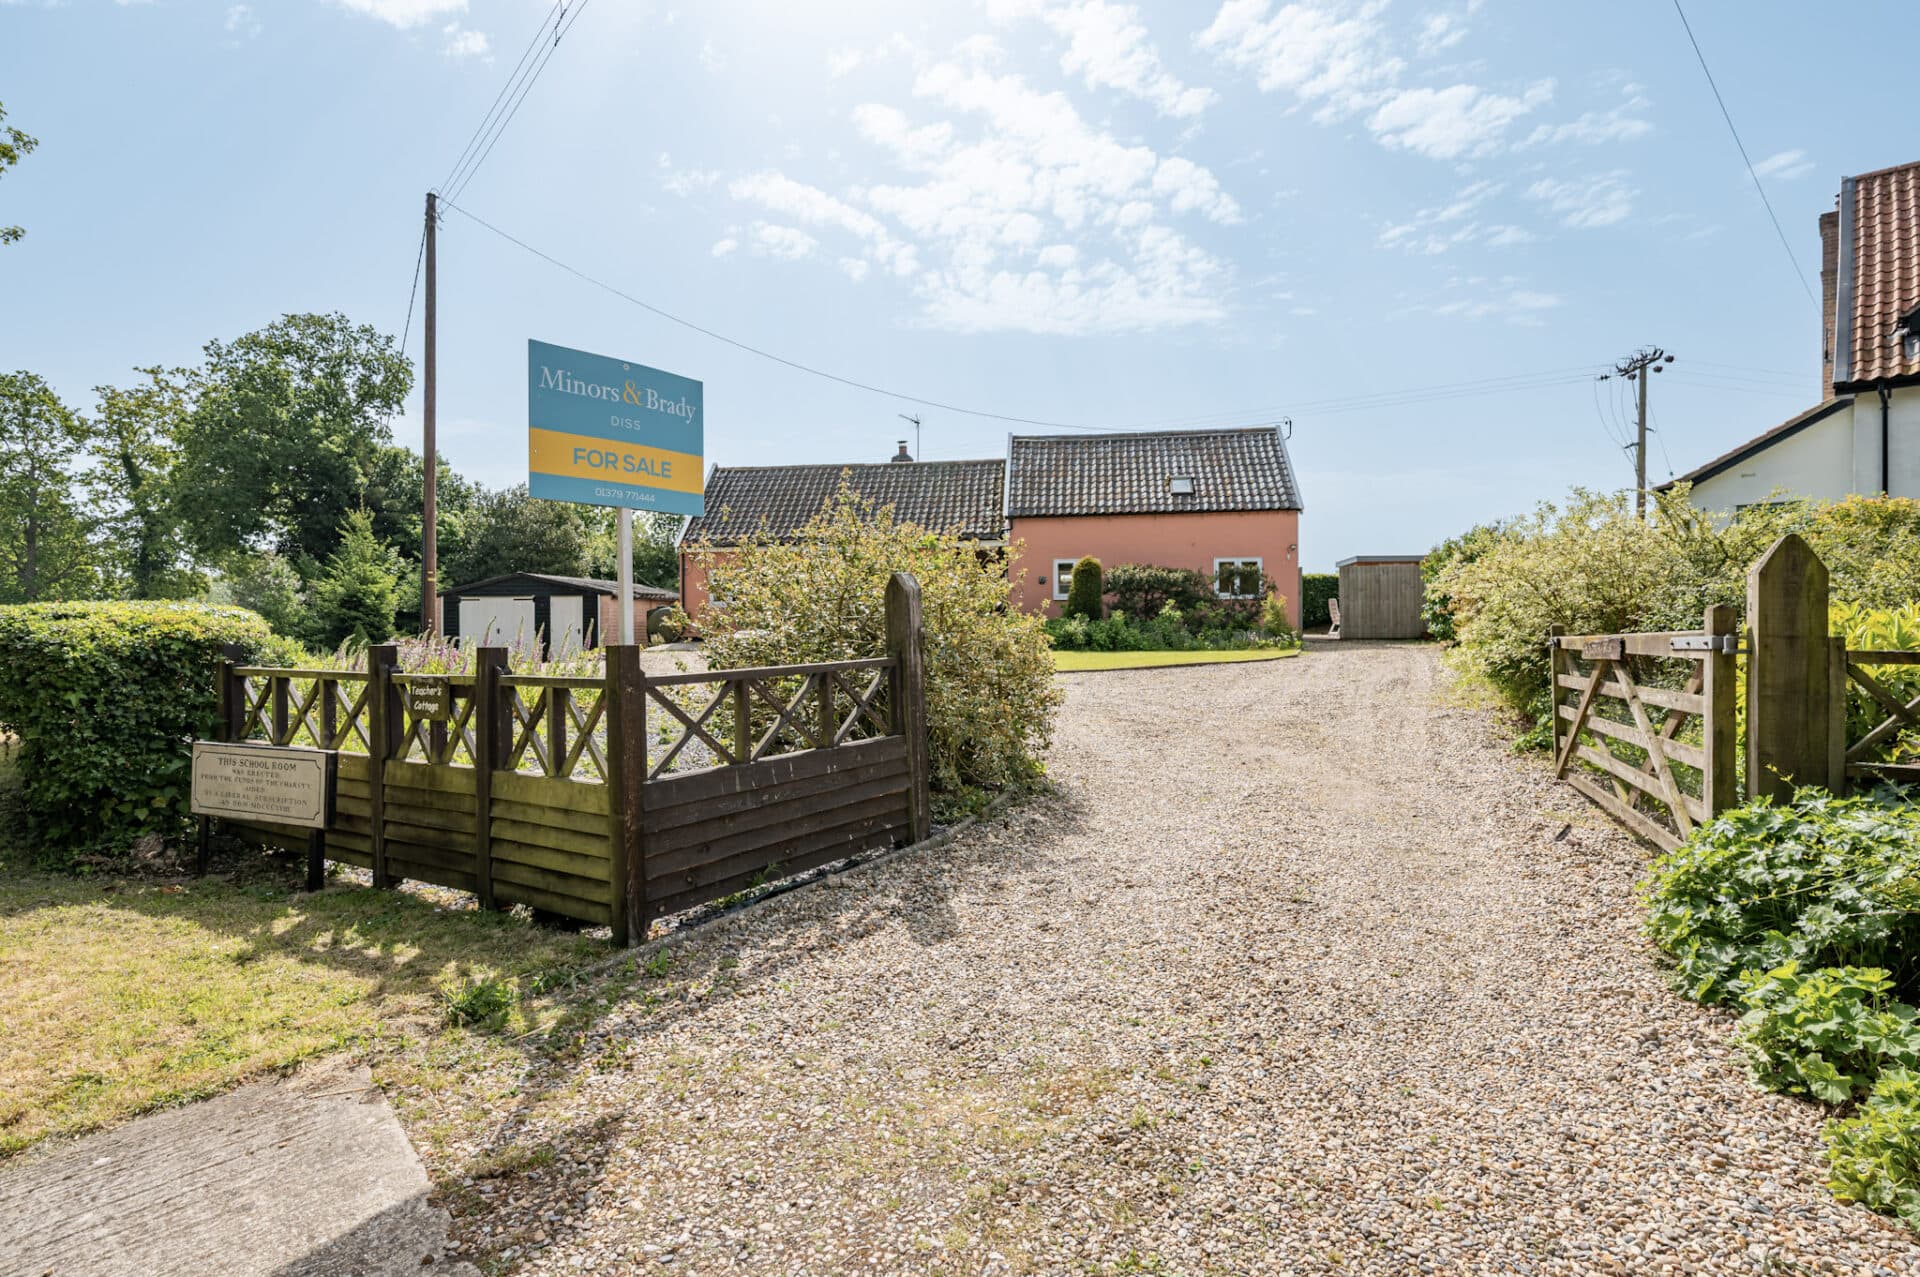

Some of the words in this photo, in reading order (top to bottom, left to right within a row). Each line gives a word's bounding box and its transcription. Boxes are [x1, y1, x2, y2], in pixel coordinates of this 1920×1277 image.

[538, 366, 620, 402] Minors
[623, 379, 643, 406] &
[646, 388, 696, 424] Brady
[610, 415, 641, 430] DISS
[573, 447, 618, 471] FOR
[623, 454, 672, 479] SALE
[595, 487, 624, 499] 01379
[625, 490, 656, 502] 771444
[412, 685, 442, 696] Teacher's
[414, 701, 439, 714] Cottage
[218, 757, 237, 767] THIS
[239, 758, 269, 770] SCHOOL
[272, 761, 297, 771] ROOM
[247, 770, 280, 778] ERECTED
